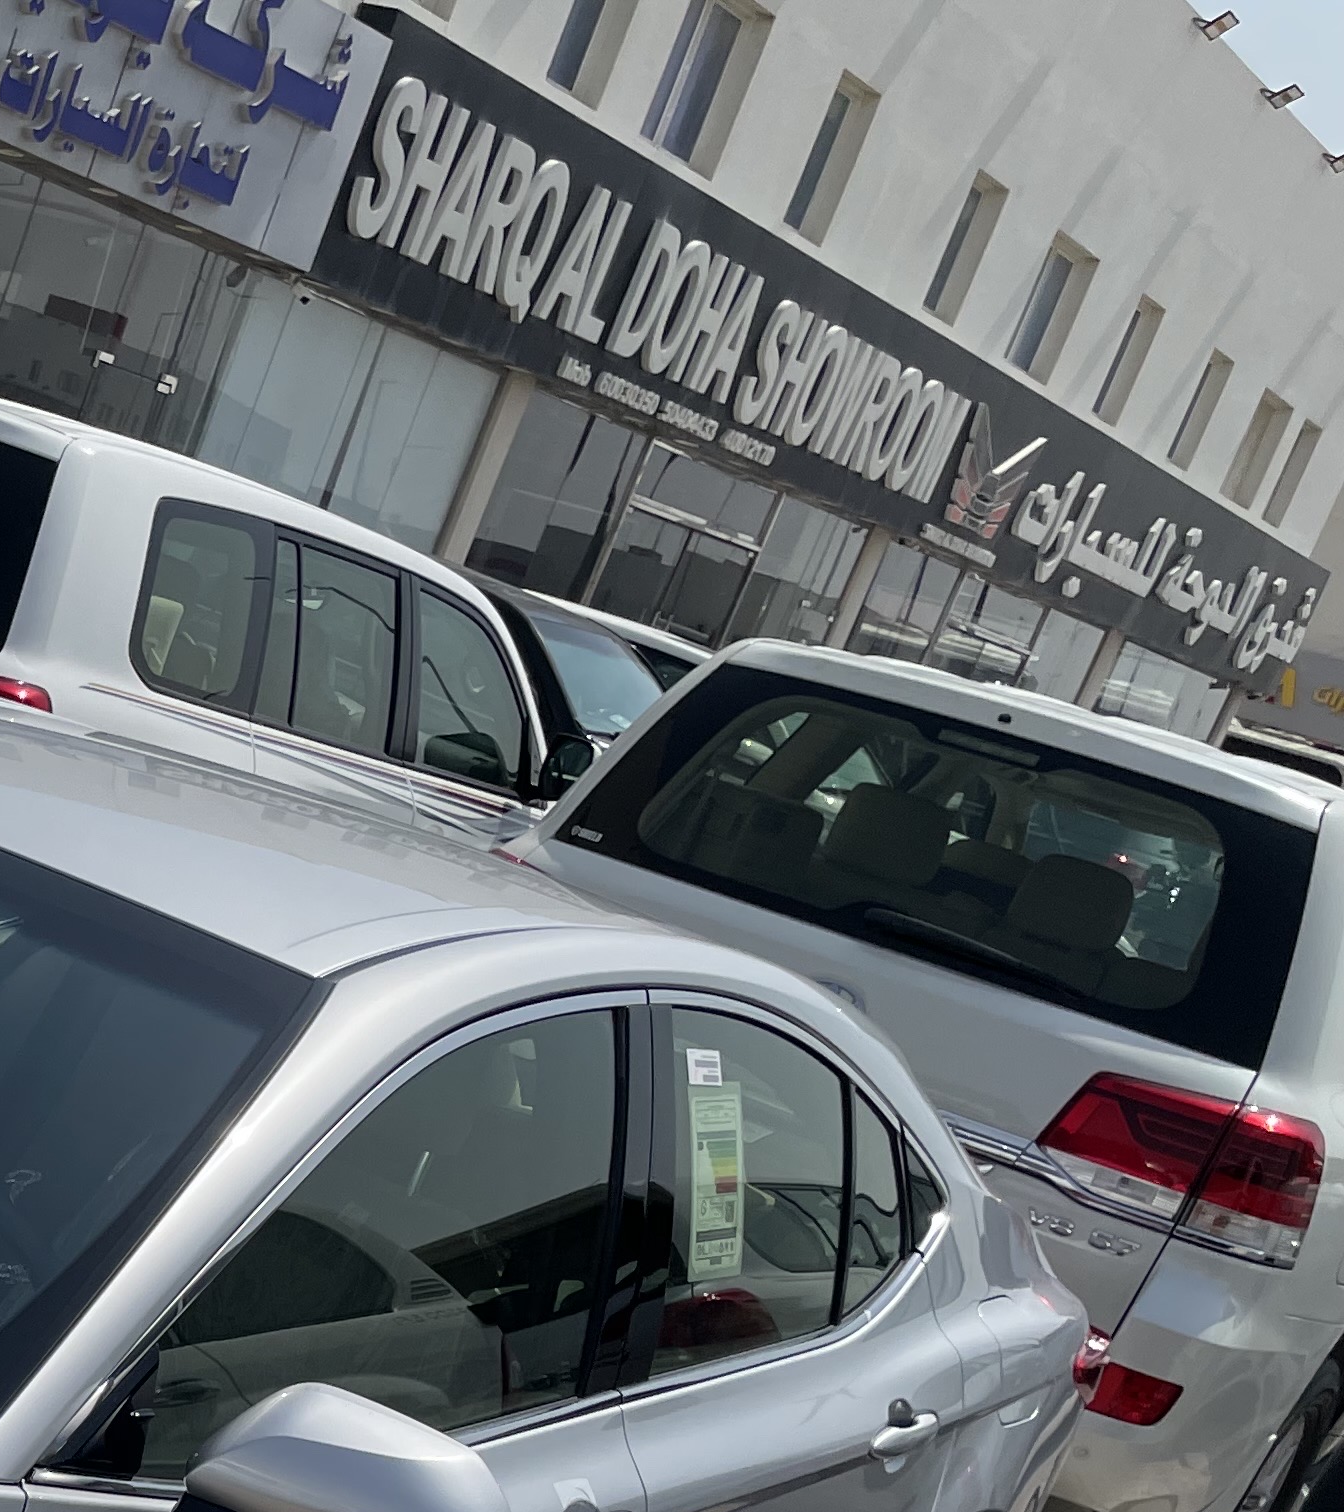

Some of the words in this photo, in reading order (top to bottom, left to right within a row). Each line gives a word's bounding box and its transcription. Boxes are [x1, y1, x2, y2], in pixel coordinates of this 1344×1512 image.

[347, 76, 570, 324] SHARQ
[530, 183, 633, 345] AL
[604, 217, 765, 405] DOHA
[733, 299, 972, 504] SHOWROOM
[1156, 527, 1269, 646] الدوحة
[1028, 1206, 1075, 1237] V8
